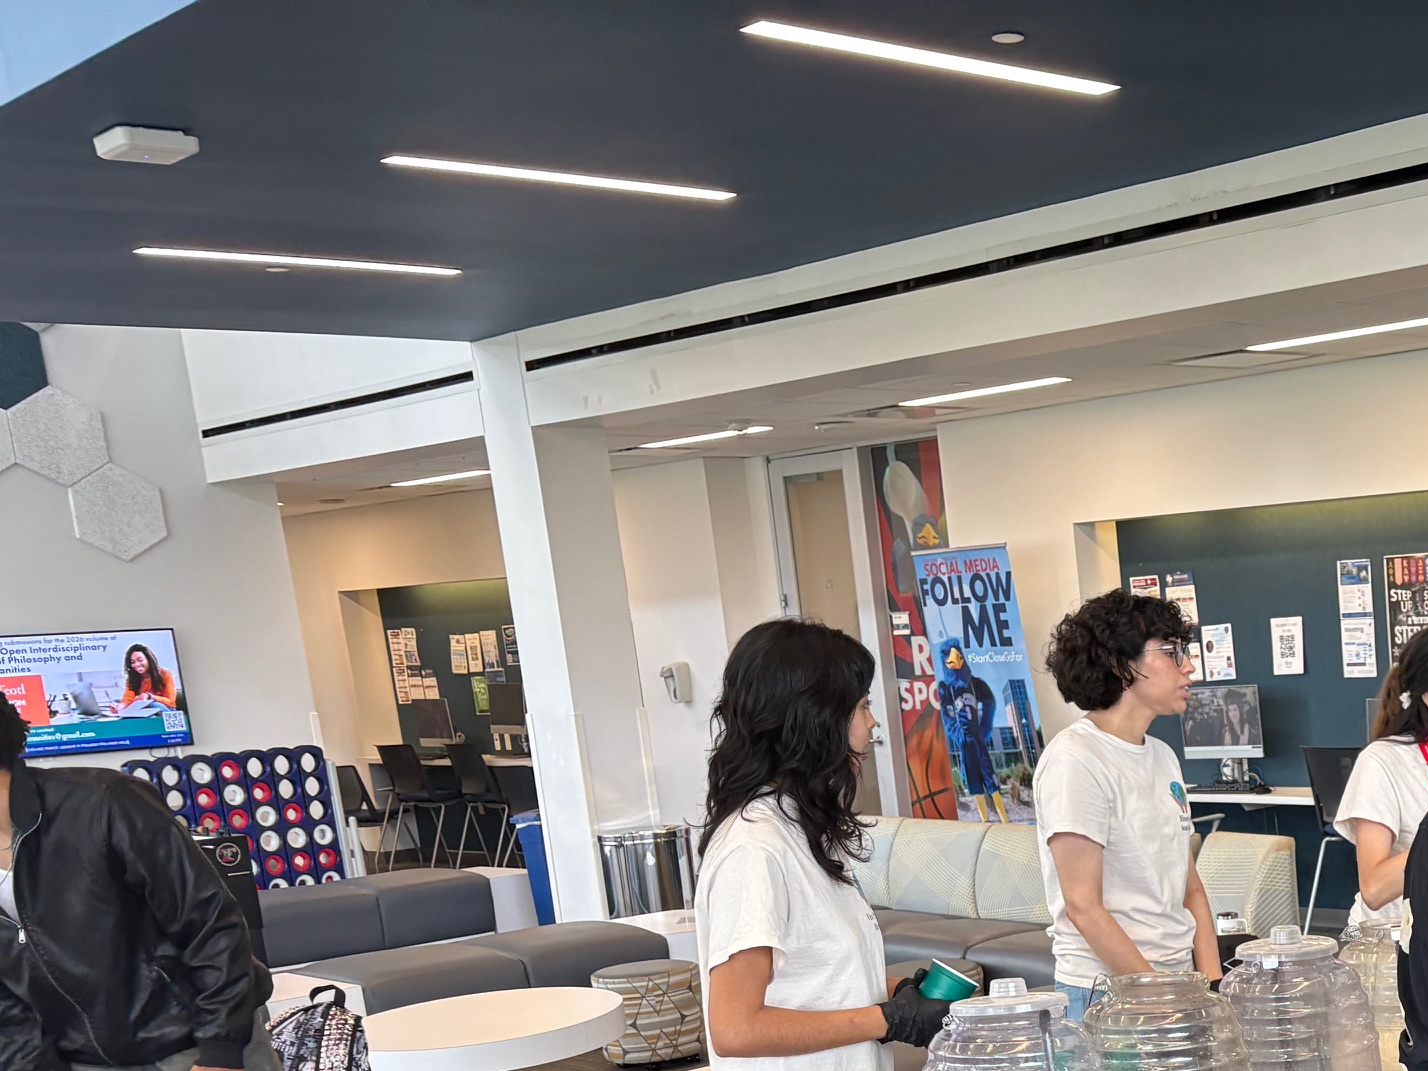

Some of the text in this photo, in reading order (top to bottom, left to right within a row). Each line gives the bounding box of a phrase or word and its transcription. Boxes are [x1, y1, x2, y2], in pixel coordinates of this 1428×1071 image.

[924, 557, 1000, 577] SOCIAL MEDIA
[919, 571, 1012, 607] FOLLOW
[1390, 588, 1412, 602] STEP
[1400, 601, 1413, 612] UP
[961, 603, 1013, 649] ME
[0, 643, 107, 656] Open Interdisciplinary
[8, 654, 61, 664] Philosophy
[64, 653, 83, 661] and
[967, 651, 1023, 663] #StartCloseGoFar
